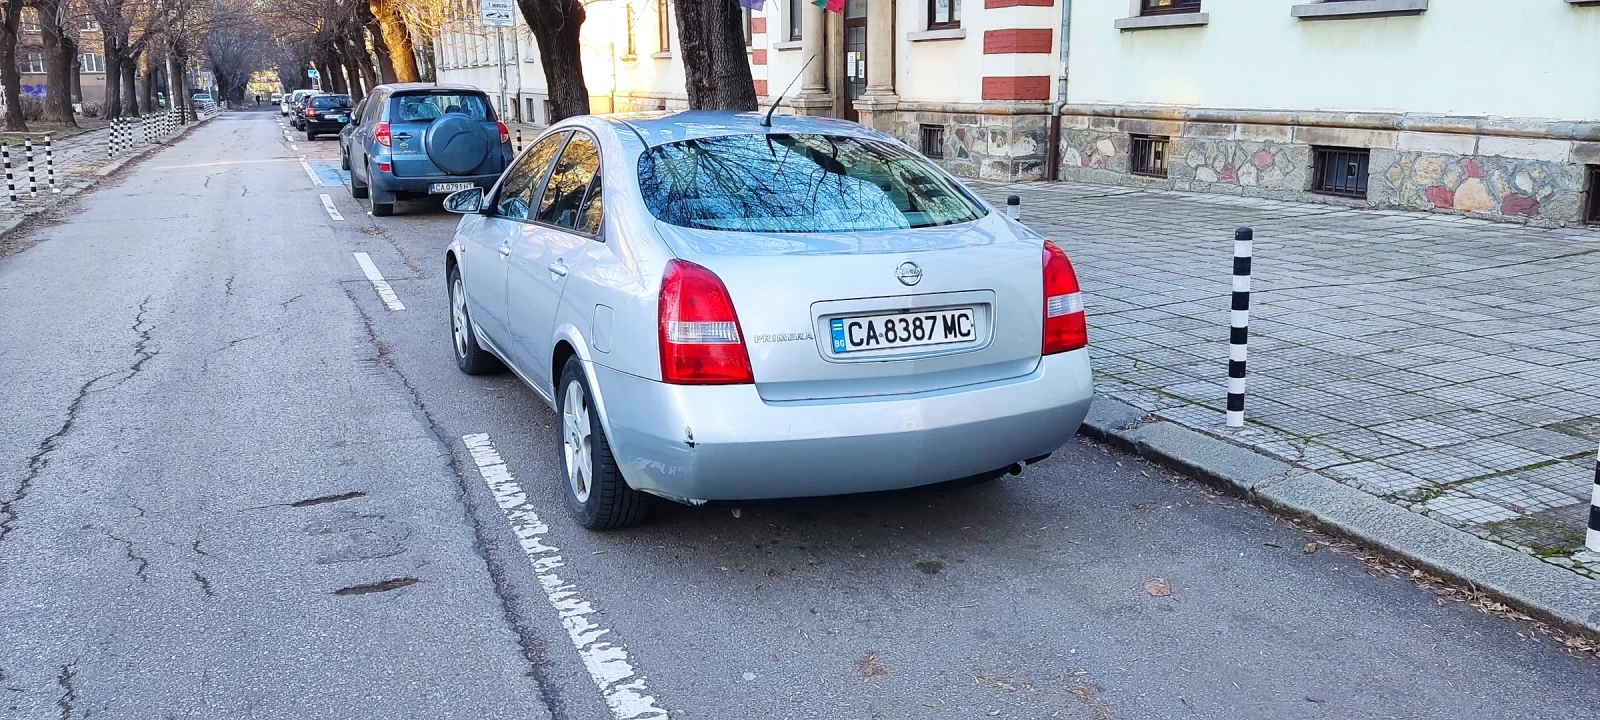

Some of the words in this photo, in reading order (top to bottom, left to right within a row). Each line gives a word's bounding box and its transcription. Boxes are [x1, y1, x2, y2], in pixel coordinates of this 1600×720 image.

[848, 320, 880, 347] CA
[884, 316, 937, 343] 8387
[942, 313, 971, 339] MC
[754, 332, 813, 343] PRIMERA
[835, 339, 845, 348] BG
